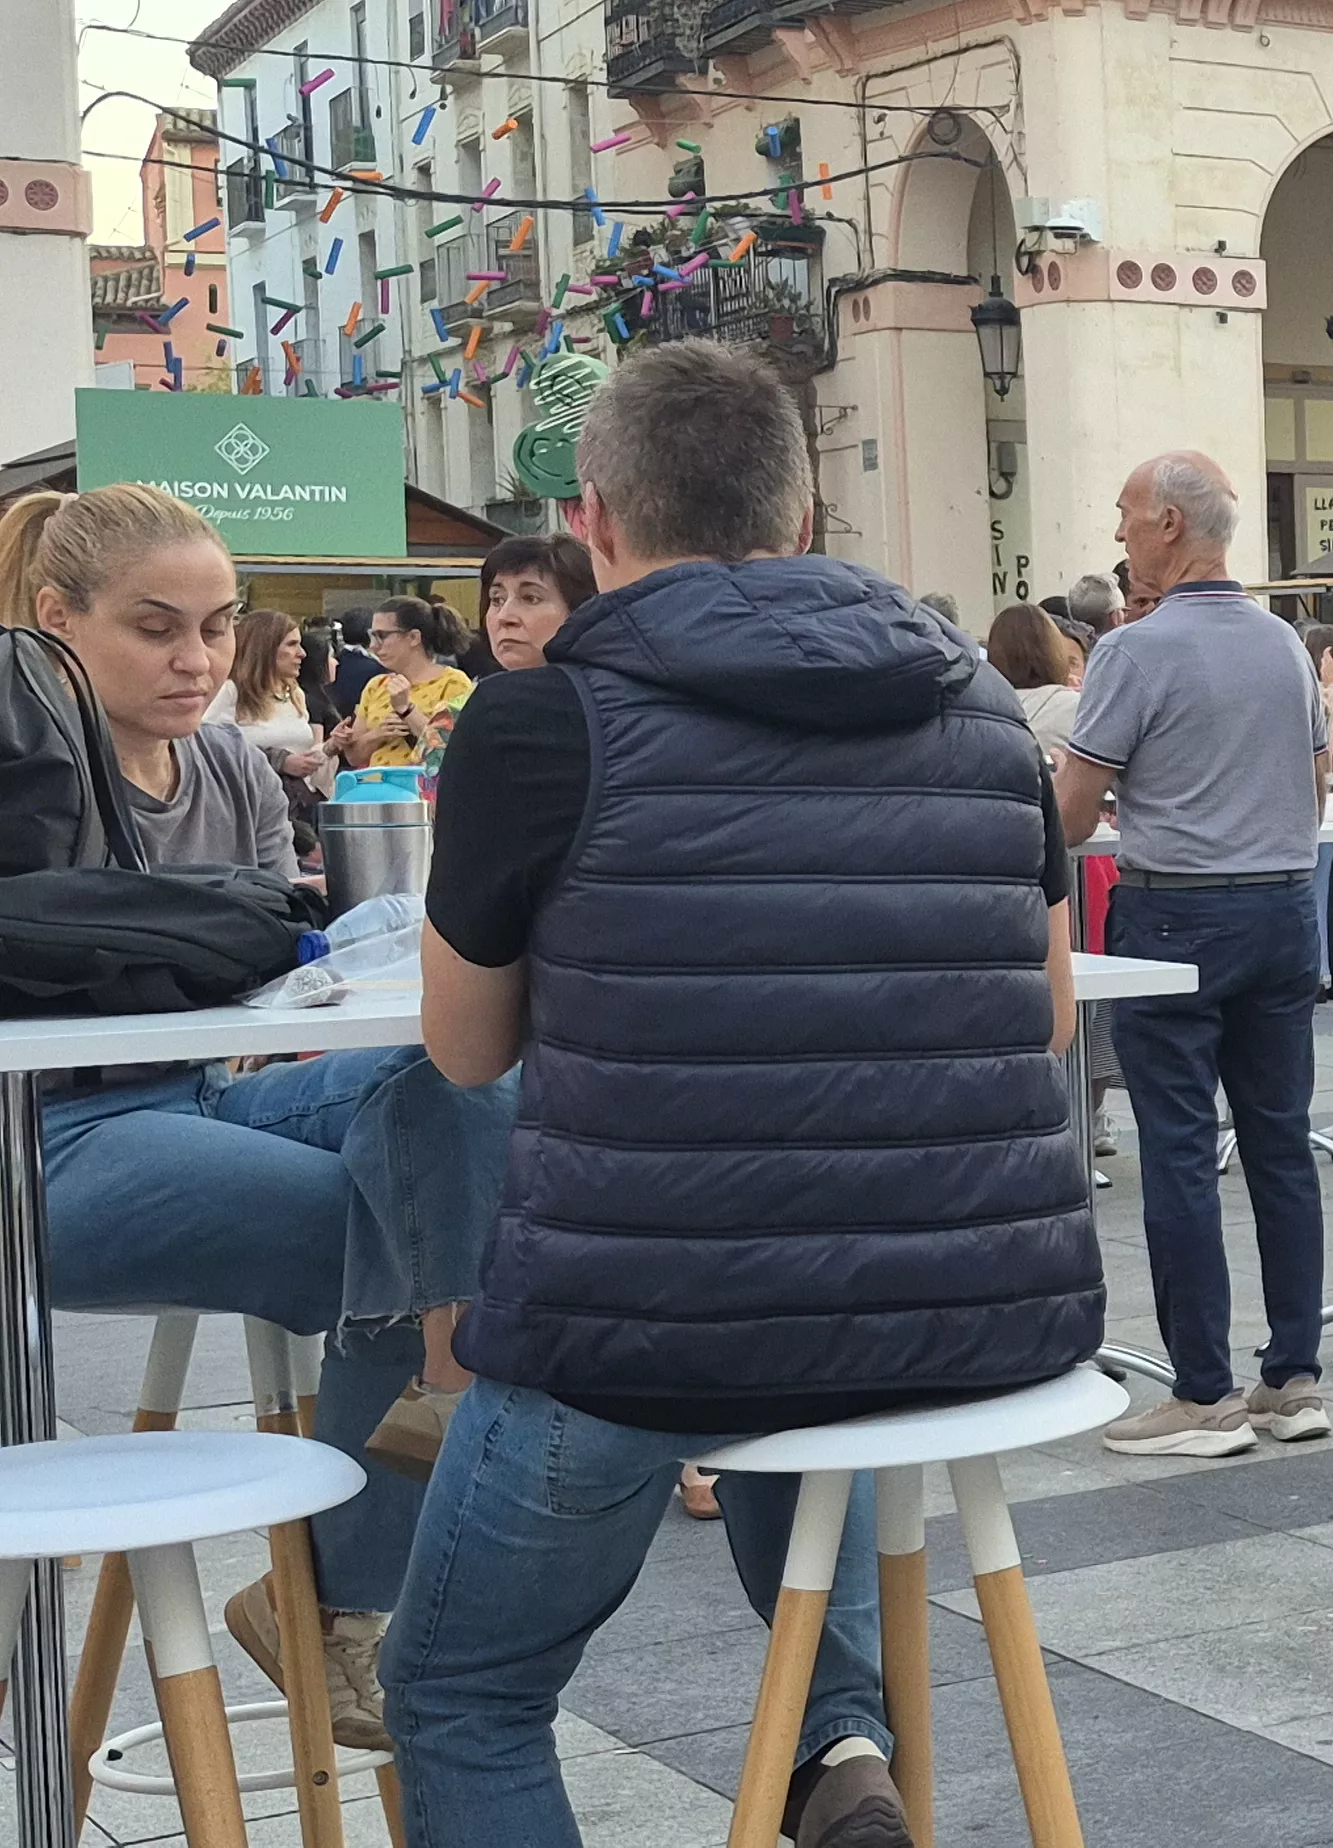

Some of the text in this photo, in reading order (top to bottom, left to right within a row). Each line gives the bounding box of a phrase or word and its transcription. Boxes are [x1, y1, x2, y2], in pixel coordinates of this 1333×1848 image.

[234, 482, 347, 502] VALANTIN
[196, 504, 295, 525] Depuis 1956
